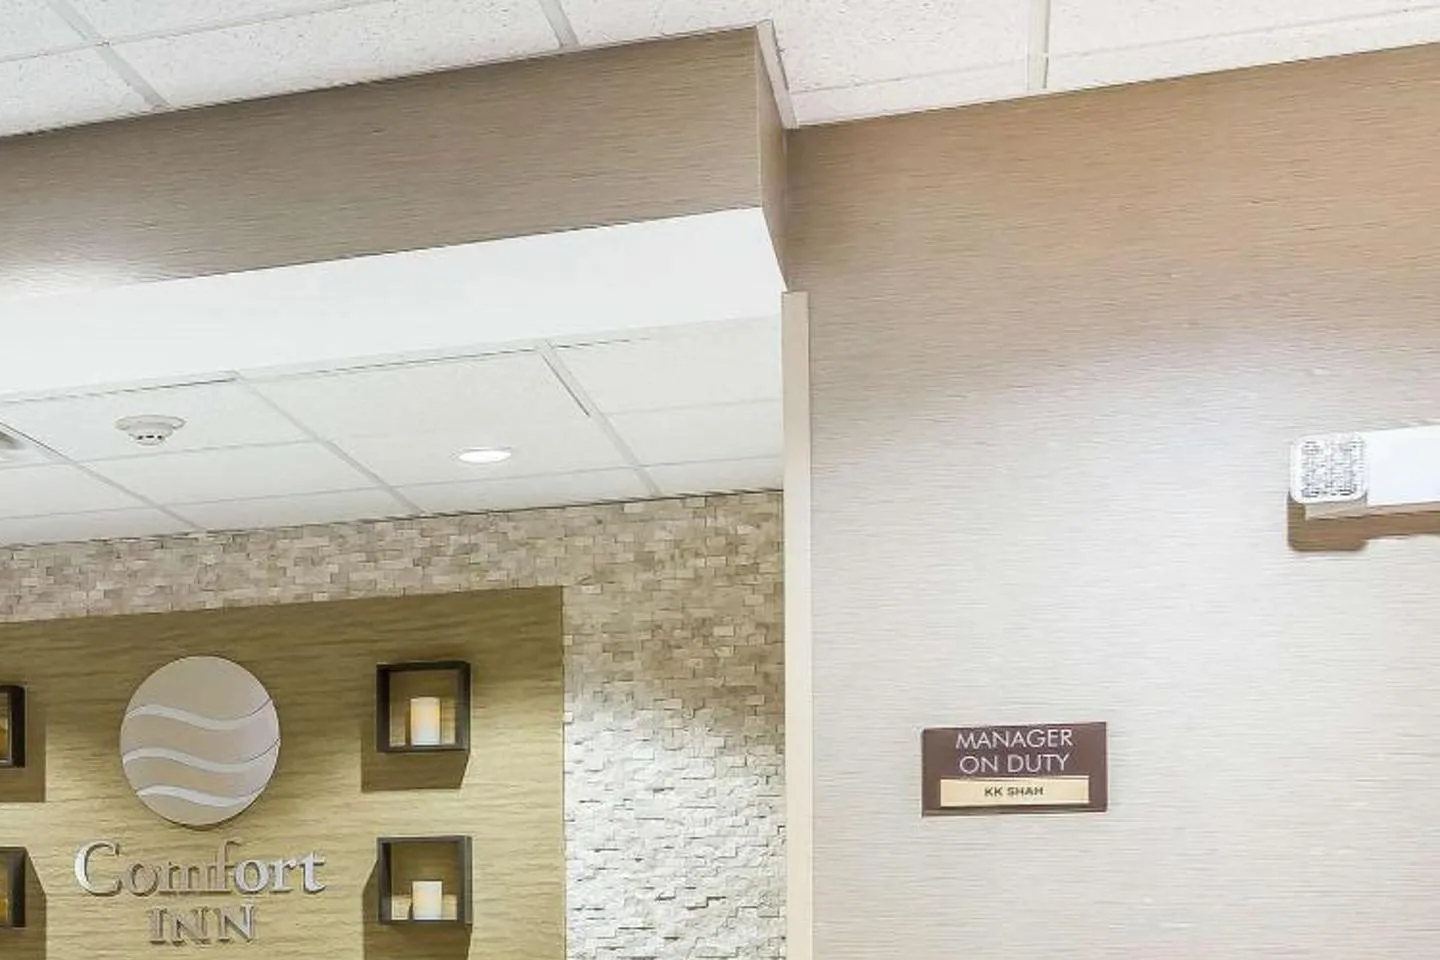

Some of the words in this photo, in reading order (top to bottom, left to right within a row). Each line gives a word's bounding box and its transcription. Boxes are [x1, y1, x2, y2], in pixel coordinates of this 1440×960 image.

[955, 729, 1074, 749] MANAGER
[959, 755, 998, 774] ON
[1007, 753, 1070, 773] DUTY
[984, 786, 1004, 797] KK
[1006, 786, 1044, 797] SHAH
[74, 837, 328, 897] Comfort
[149, 902, 258, 946] INN
